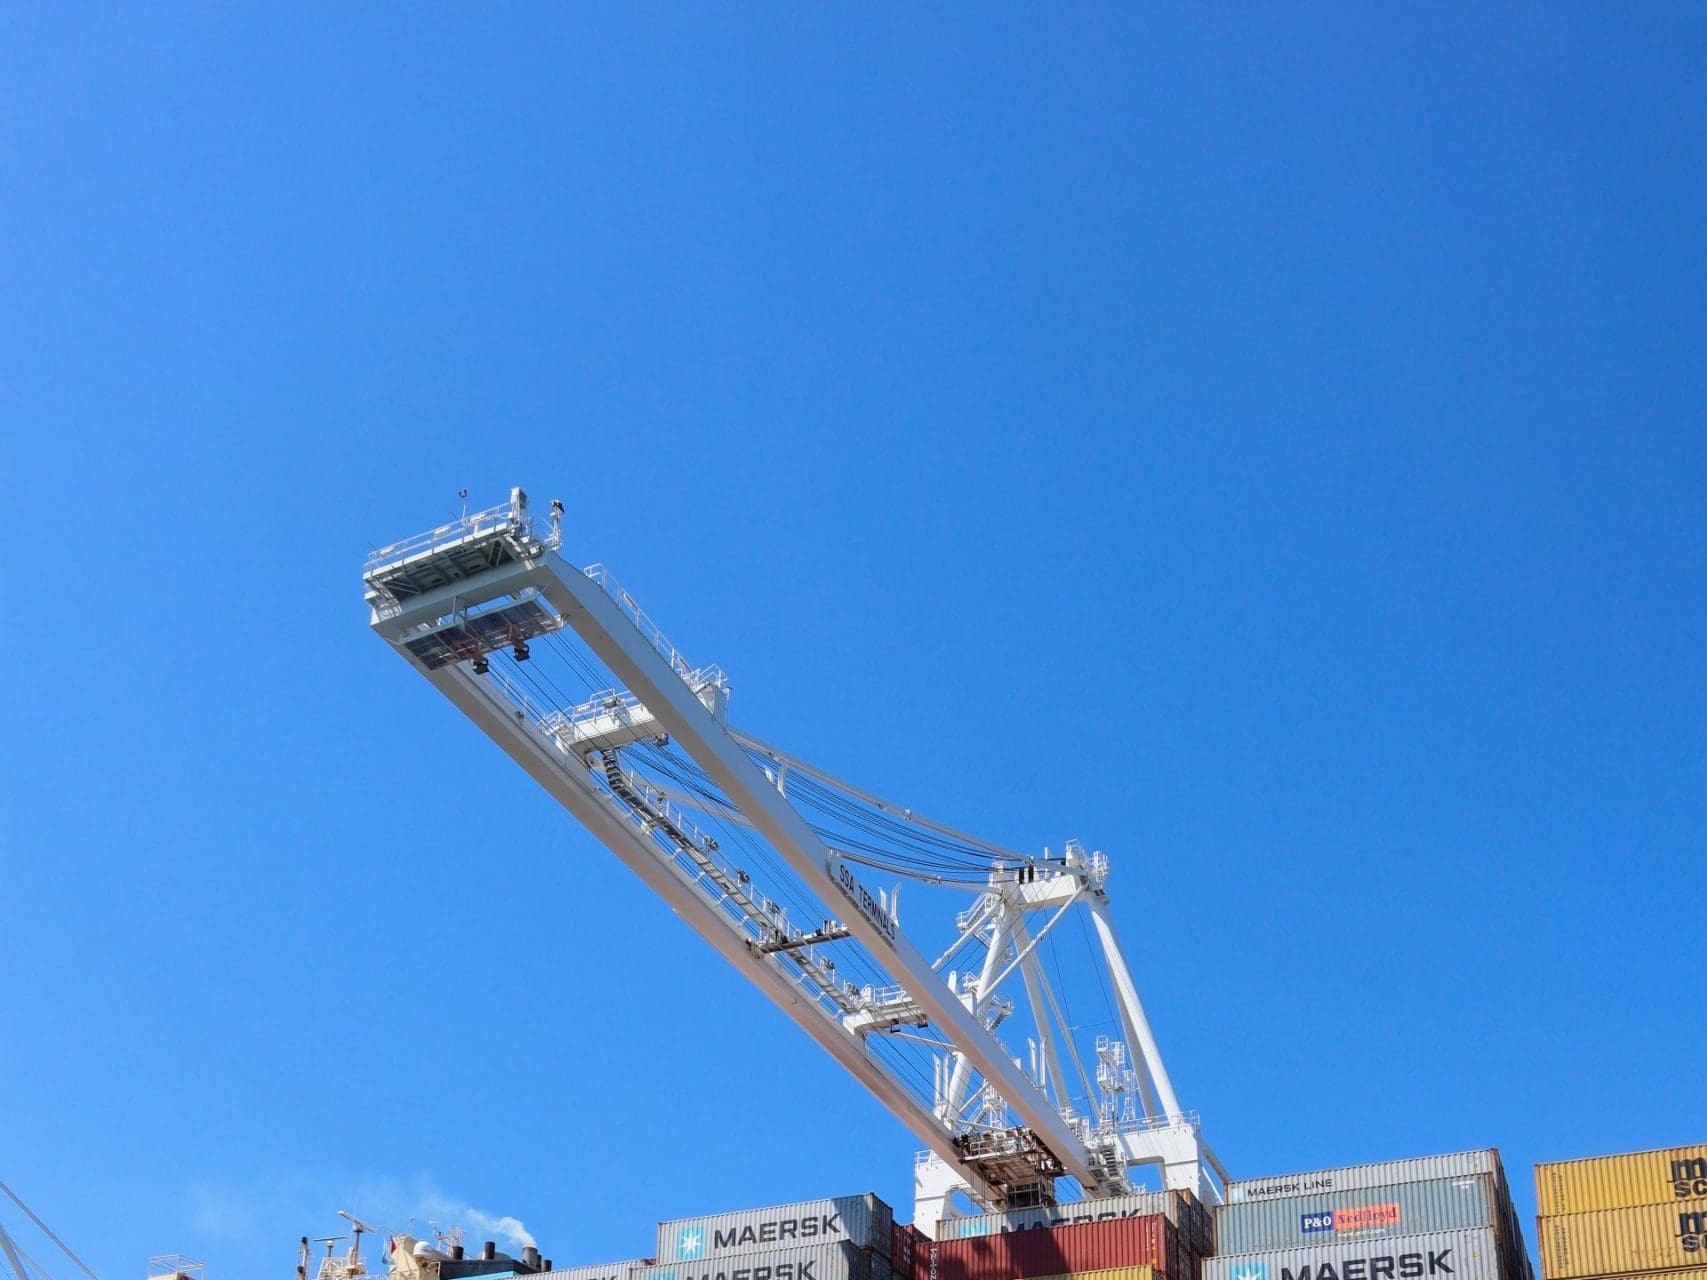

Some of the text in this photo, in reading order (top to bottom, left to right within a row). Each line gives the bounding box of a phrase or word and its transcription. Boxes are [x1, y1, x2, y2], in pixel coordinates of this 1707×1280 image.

[840, 864, 896, 940] SSA TERMINALS
[1247, 1179, 1334, 1197] MAERSK LINE
[714, 1213, 841, 1249] MAERSK
[1304, 1216, 1332, 1230] P&O
